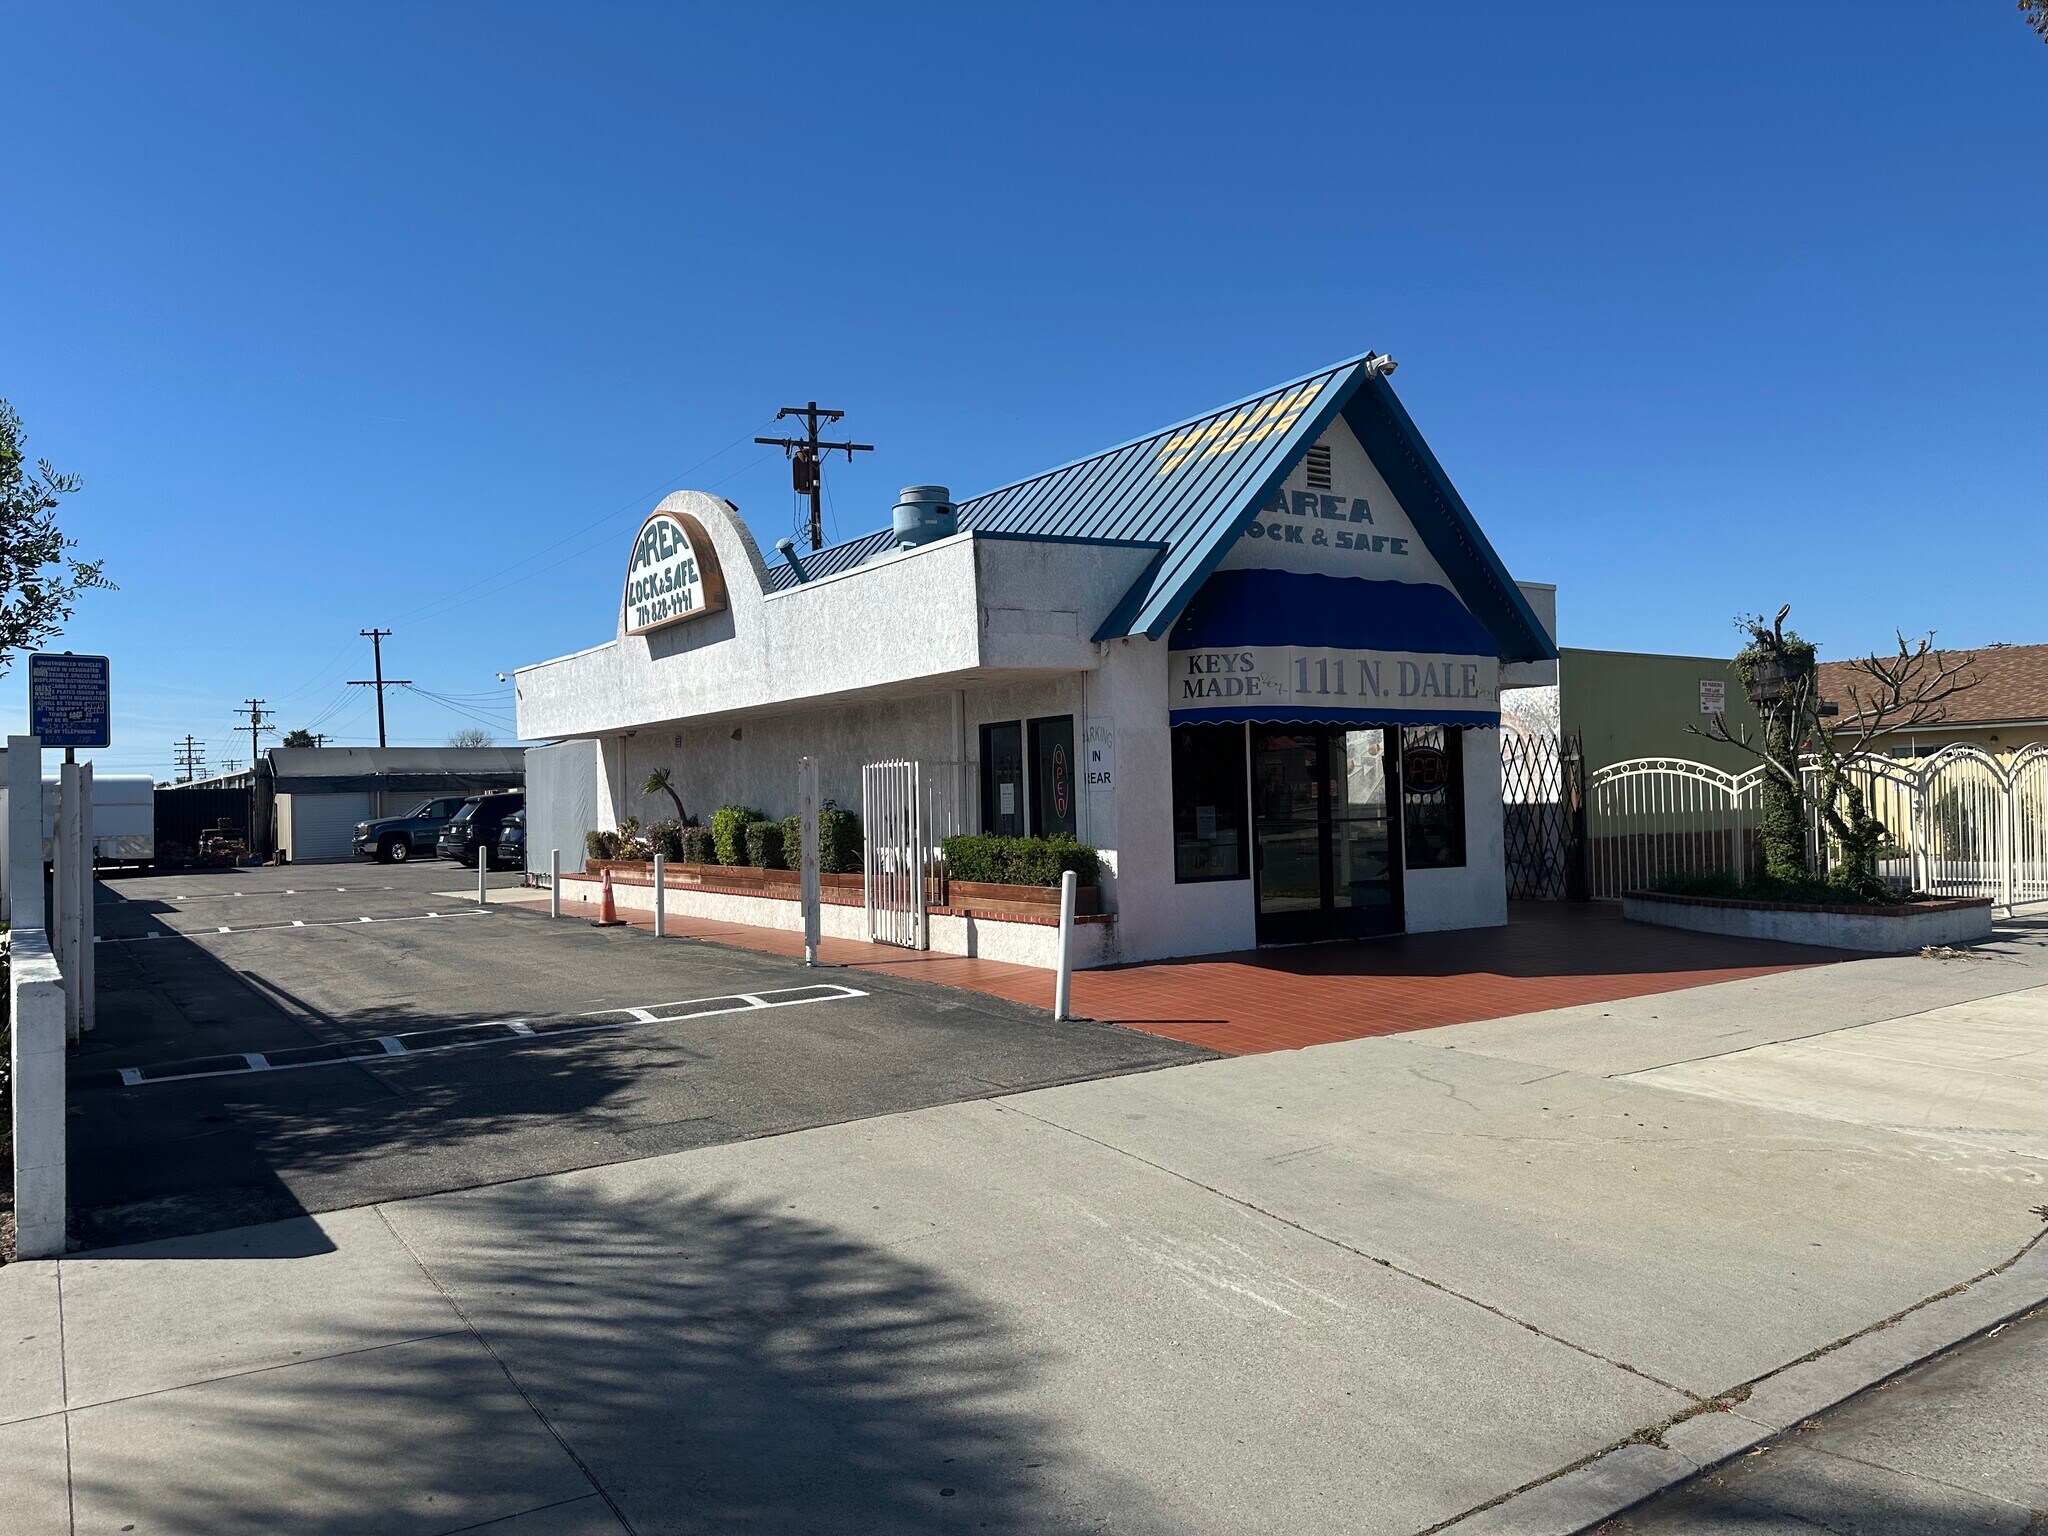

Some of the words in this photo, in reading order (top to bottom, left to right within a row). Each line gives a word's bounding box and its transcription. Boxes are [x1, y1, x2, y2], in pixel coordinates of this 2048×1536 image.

[1263, 488, 1374, 525] AREA
[631, 520, 689, 573] AREA
[1242, 519, 1304, 545] OCK
[1311, 527, 1329, 547] &
[1335, 530, 1408, 556] SAFE
[636, 604, 650, 626] 714
[1182, 676, 1262, 699] MADE
[1188, 652, 1255, 675] KEYS
[1294, 656, 1348, 696] 111
[1357, 659, 1390, 697] N.
[1398, 660, 1479, 699] DALE
[1092, 750, 1101, 762] IN
